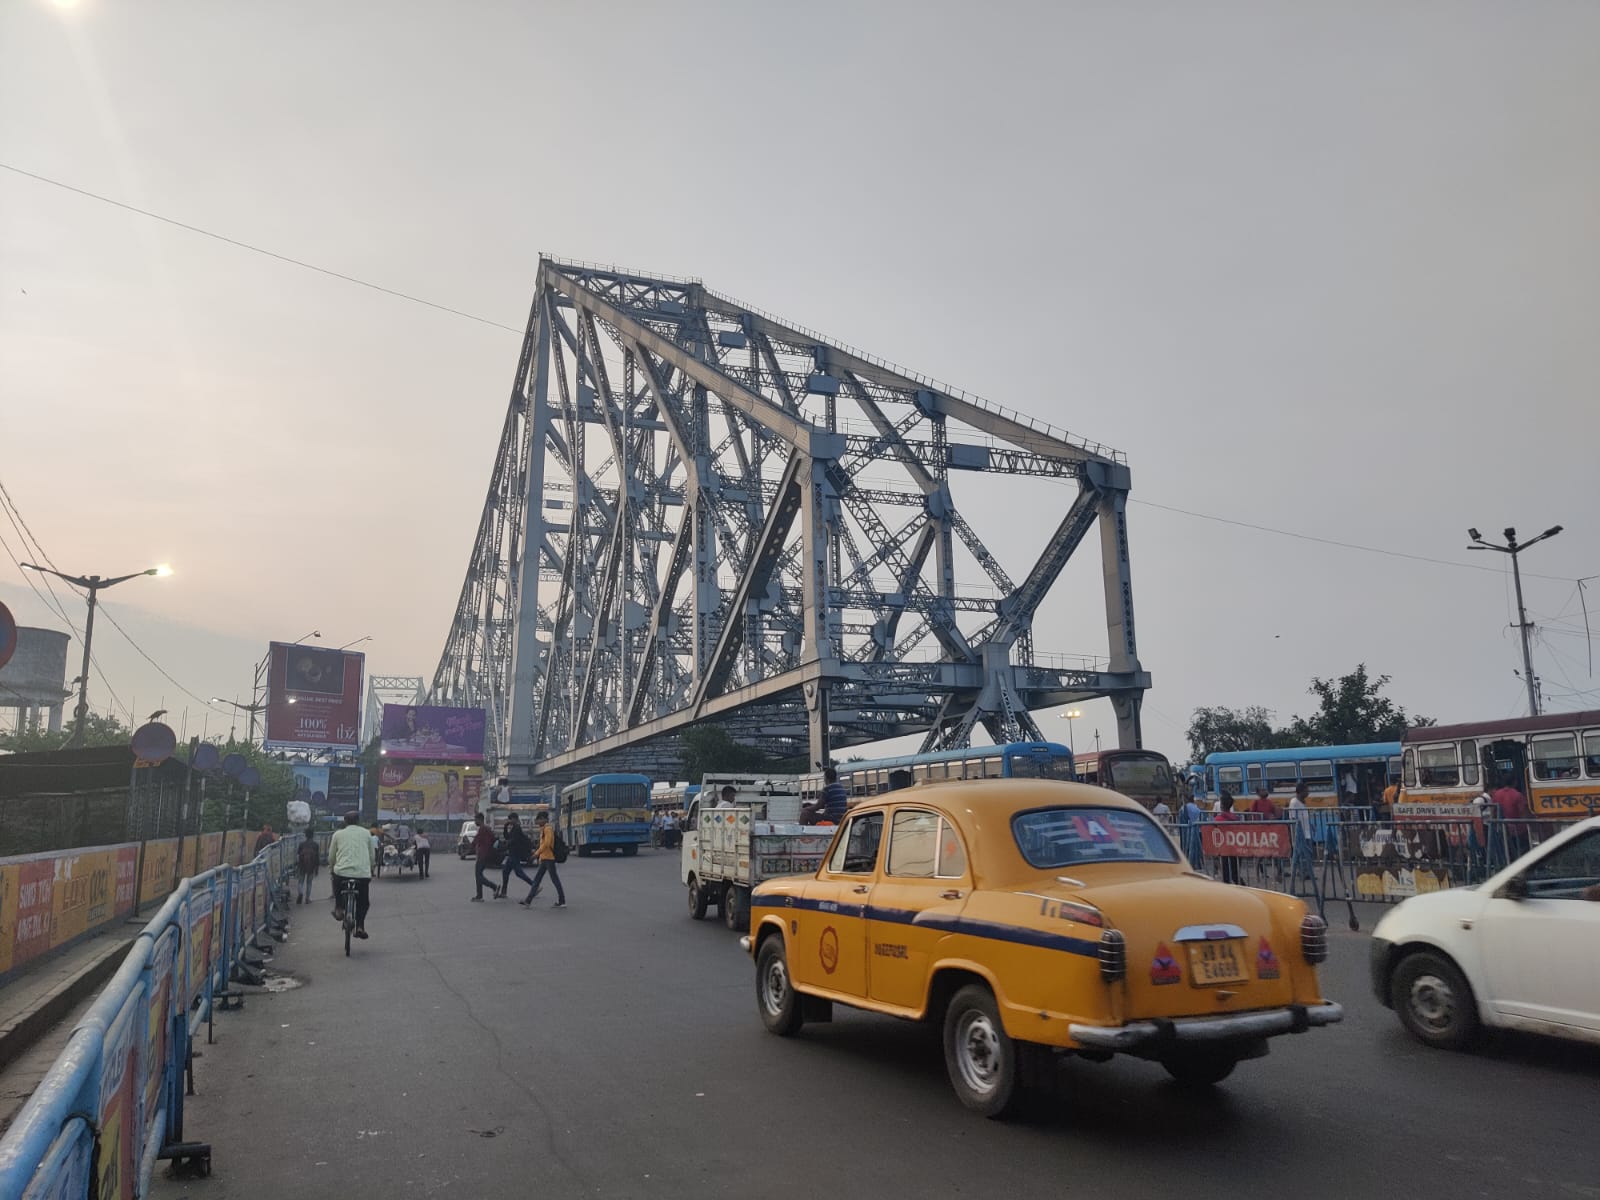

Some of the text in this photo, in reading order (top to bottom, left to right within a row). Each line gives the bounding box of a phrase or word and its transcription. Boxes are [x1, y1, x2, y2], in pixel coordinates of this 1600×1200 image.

[1397, 806, 1414, 815] SAFE
[1416, 806, 1436, 815] DRIVE
[1225, 831, 1280, 848] DOLLAR
